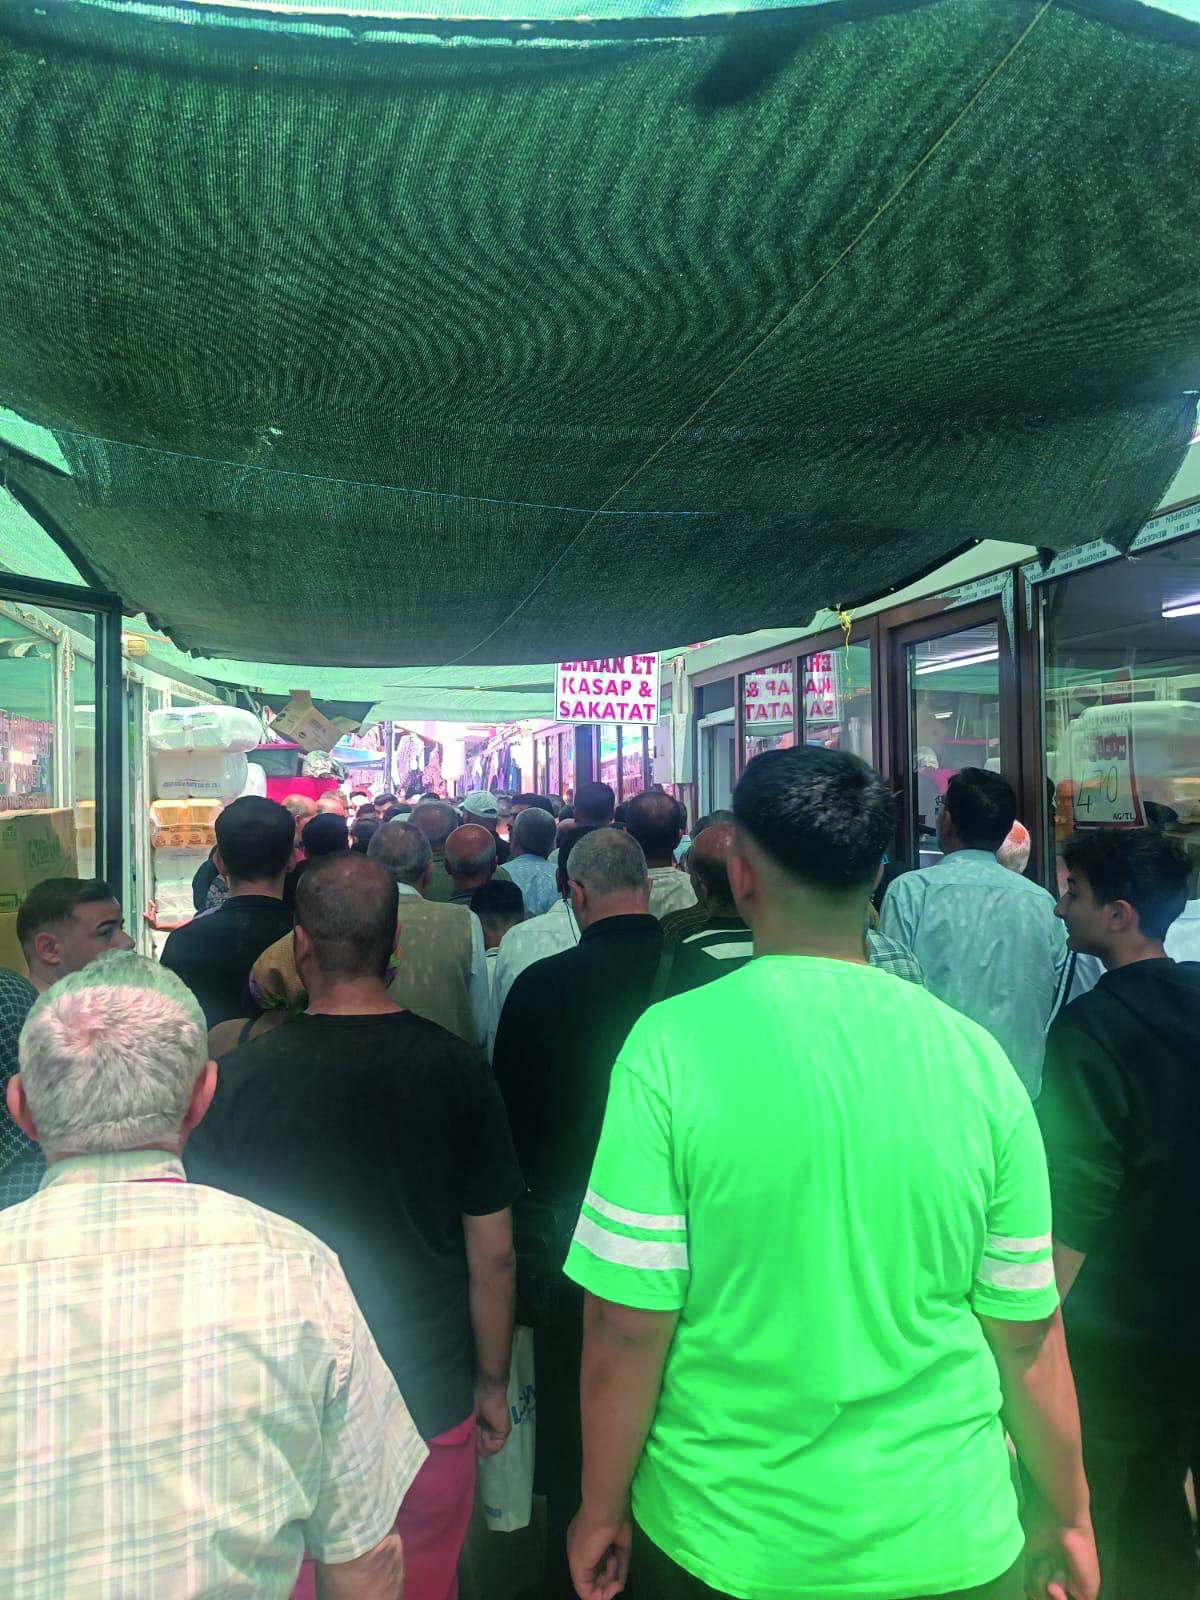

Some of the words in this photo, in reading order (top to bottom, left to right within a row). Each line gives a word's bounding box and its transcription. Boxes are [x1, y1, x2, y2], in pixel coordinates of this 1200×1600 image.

[631, 656, 656, 675] ET
[561, 678, 632, 697] KASAP
[639, 681, 652, 697] &
[560, 701, 656, 720] SAKATAT
[1076, 766, 1118, 814] 470
